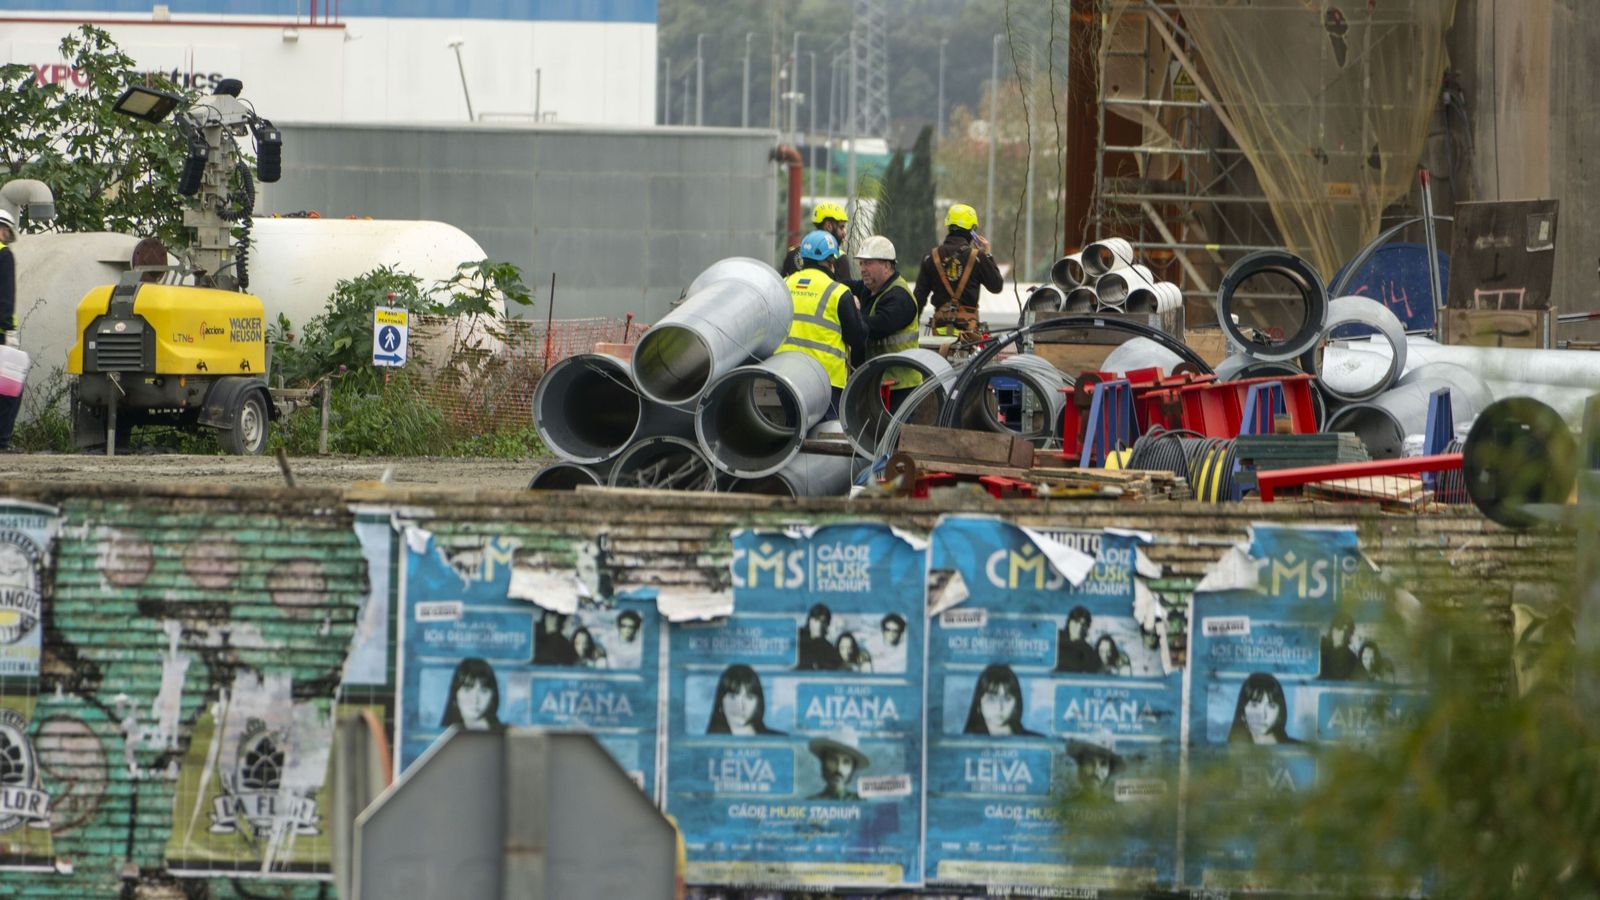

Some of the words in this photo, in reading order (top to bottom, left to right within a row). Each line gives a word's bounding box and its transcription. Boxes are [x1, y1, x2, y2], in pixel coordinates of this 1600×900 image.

[229, 318, 262, 330] WACKER
[230, 330, 262, 342] NEUSON
[730, 543, 805, 589] CMS
[816, 562, 870, 580] MUSIC
[816, 578, 871, 593] STADIUM
[540, 690, 634, 717] AITANA
[804, 695, 900, 721] AITANA
[1063, 698, 1157, 723] AITANA
[708, 757, 776, 784] LEIVA
[964, 757, 1033, 784] LEIVA
[3, 790, 41, 814] LOR
[769, 805, 806, 819] MUSIC
[808, 804, 861, 820] STADIUM
